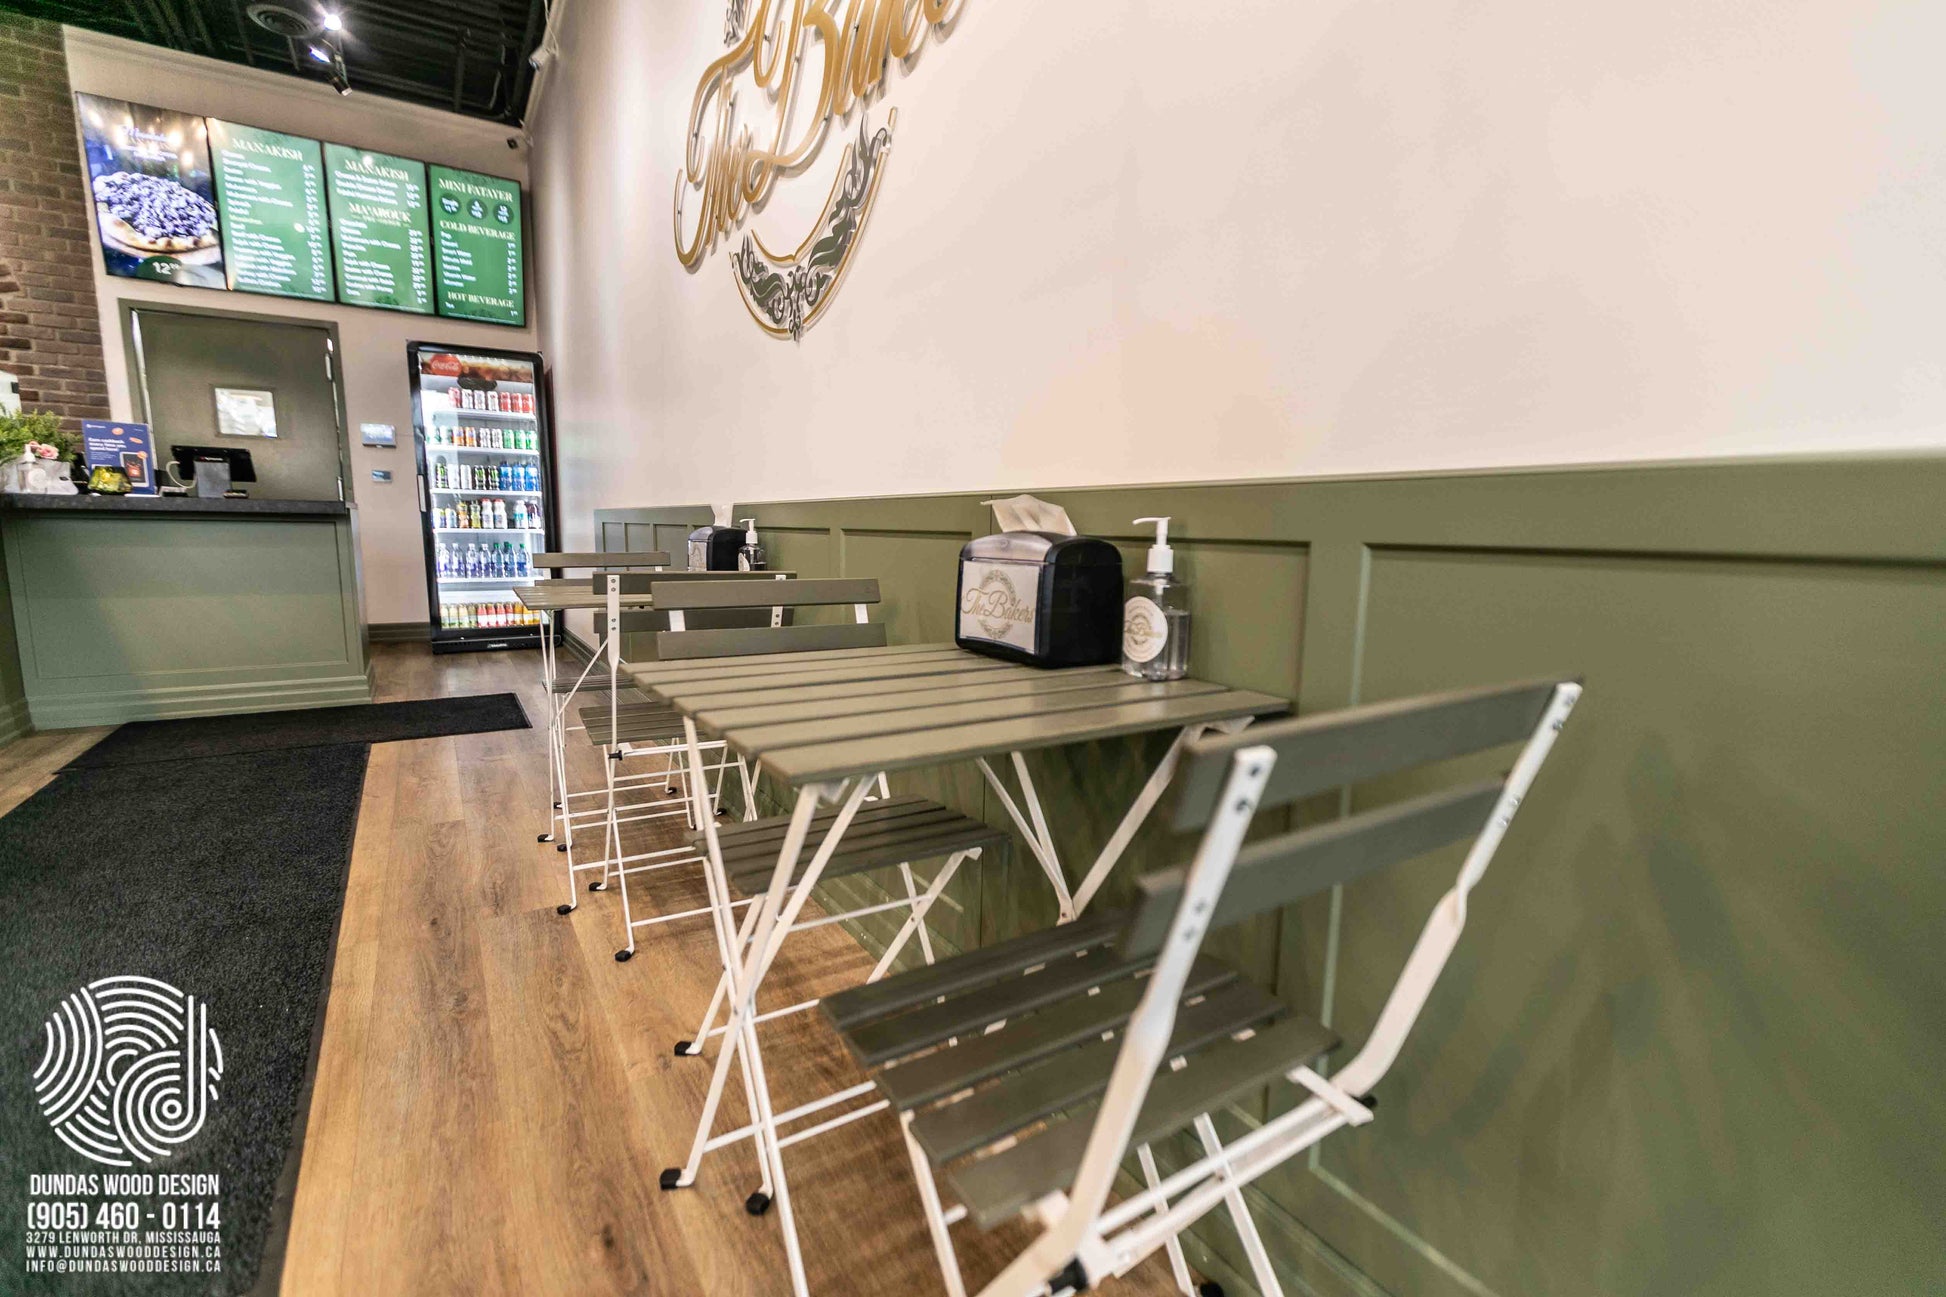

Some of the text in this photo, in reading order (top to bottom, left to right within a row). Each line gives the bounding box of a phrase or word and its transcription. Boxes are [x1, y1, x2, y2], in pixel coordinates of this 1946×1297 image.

[345, 159, 409, 181] MANAKISH
[438, 178, 513, 202] MINI FATAYER
[440, 220, 516, 241] COLD BEVERAGE
[447, 291, 515, 308] HOT BEVERAGE
[983, 590, 1035, 624] Bakers
